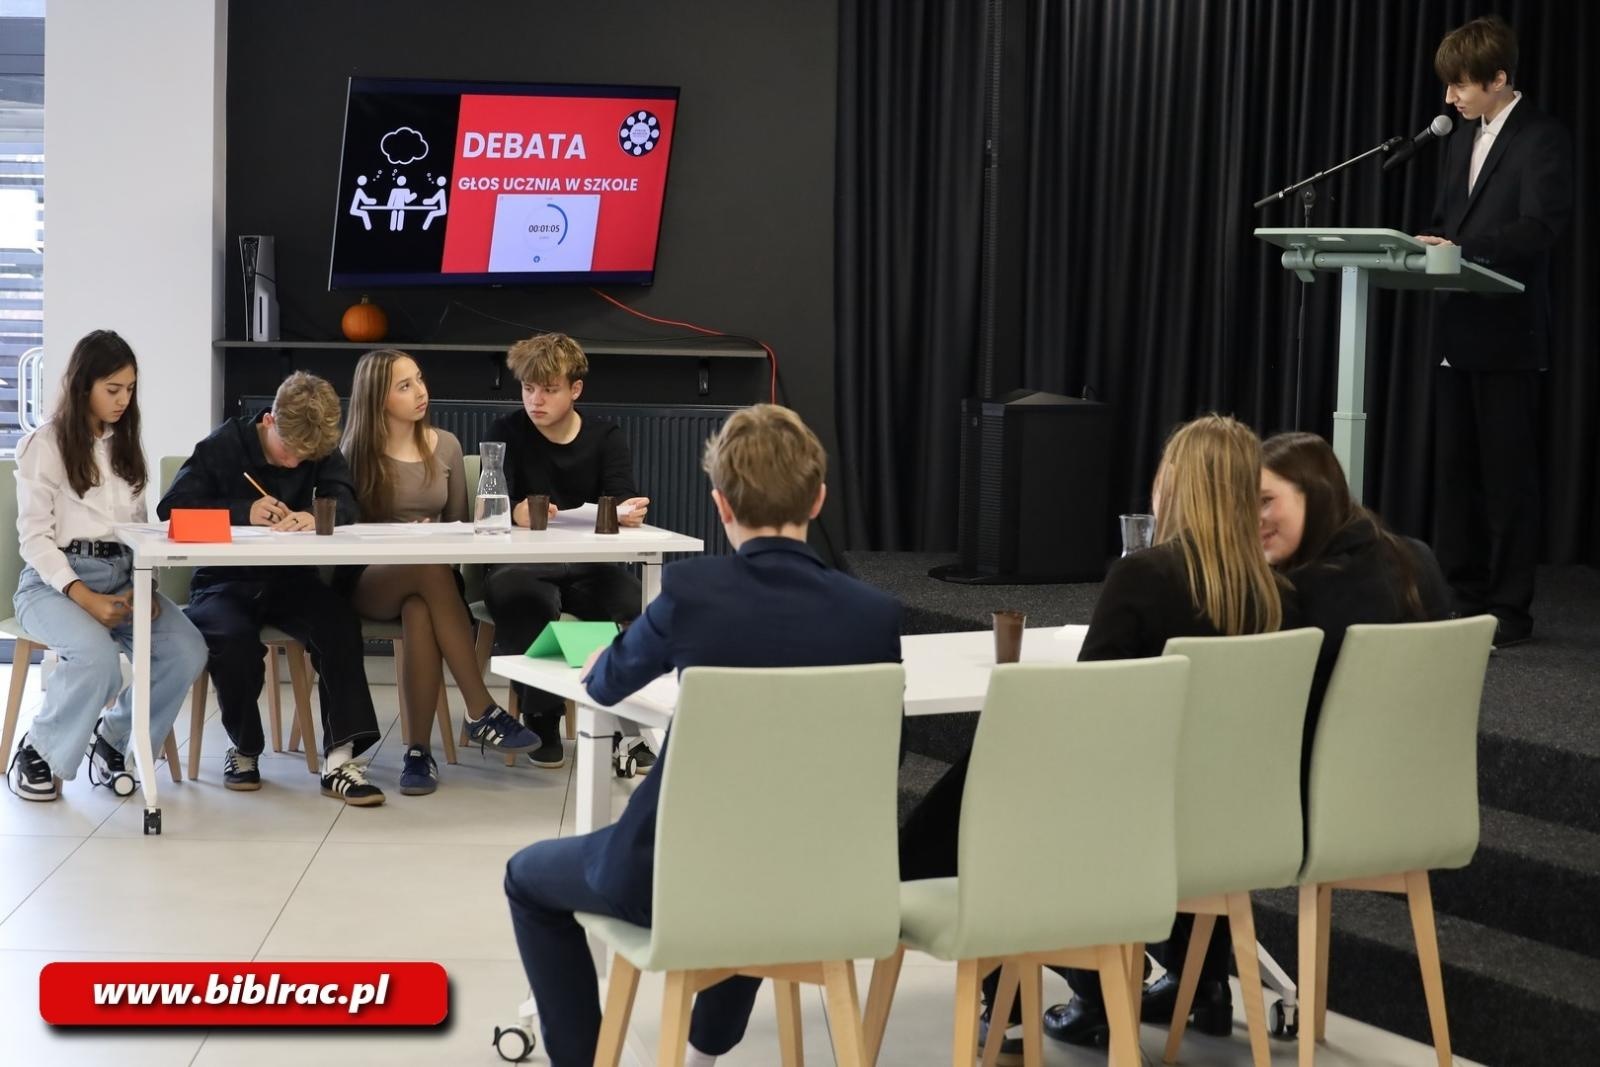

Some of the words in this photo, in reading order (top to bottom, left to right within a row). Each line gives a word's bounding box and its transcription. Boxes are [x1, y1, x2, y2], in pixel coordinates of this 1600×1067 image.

[462, 131, 587, 160] DEBATA
[458, 176, 499, 191] GŁOS
[503, 177, 561, 191] UCZNIA
[565, 178, 581, 191] W
[583, 178, 638, 191] SZKOLE
[528, 224, 560, 233] 00:01:05
